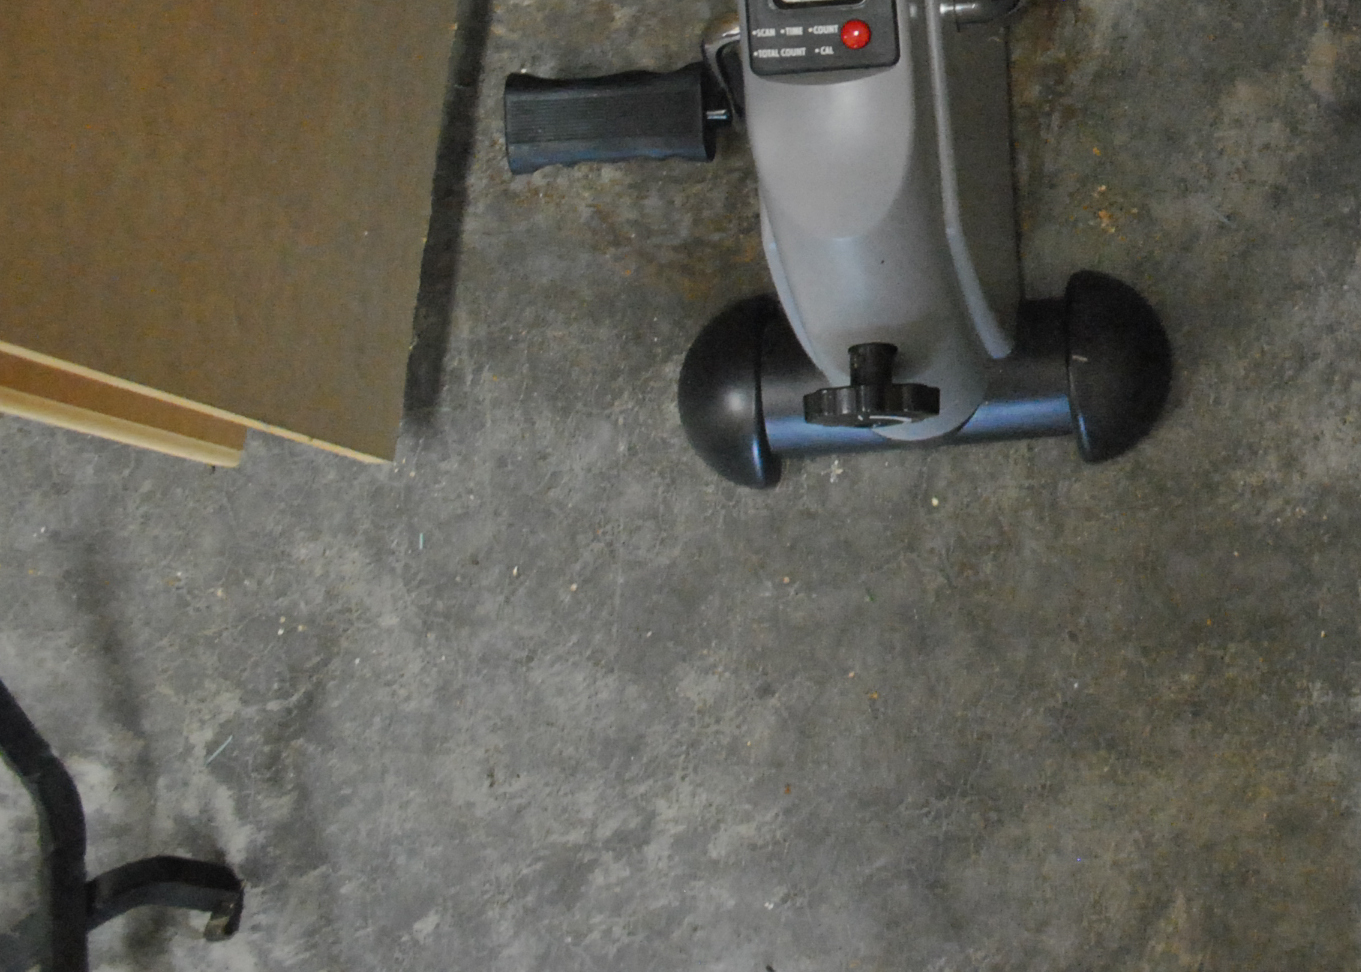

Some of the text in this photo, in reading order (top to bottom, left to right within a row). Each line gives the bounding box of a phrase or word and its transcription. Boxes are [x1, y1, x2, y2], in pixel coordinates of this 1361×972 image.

[812, 24, 839, 35] COUNT
[758, 46, 835, 58] TOTAL COUNT CAL
